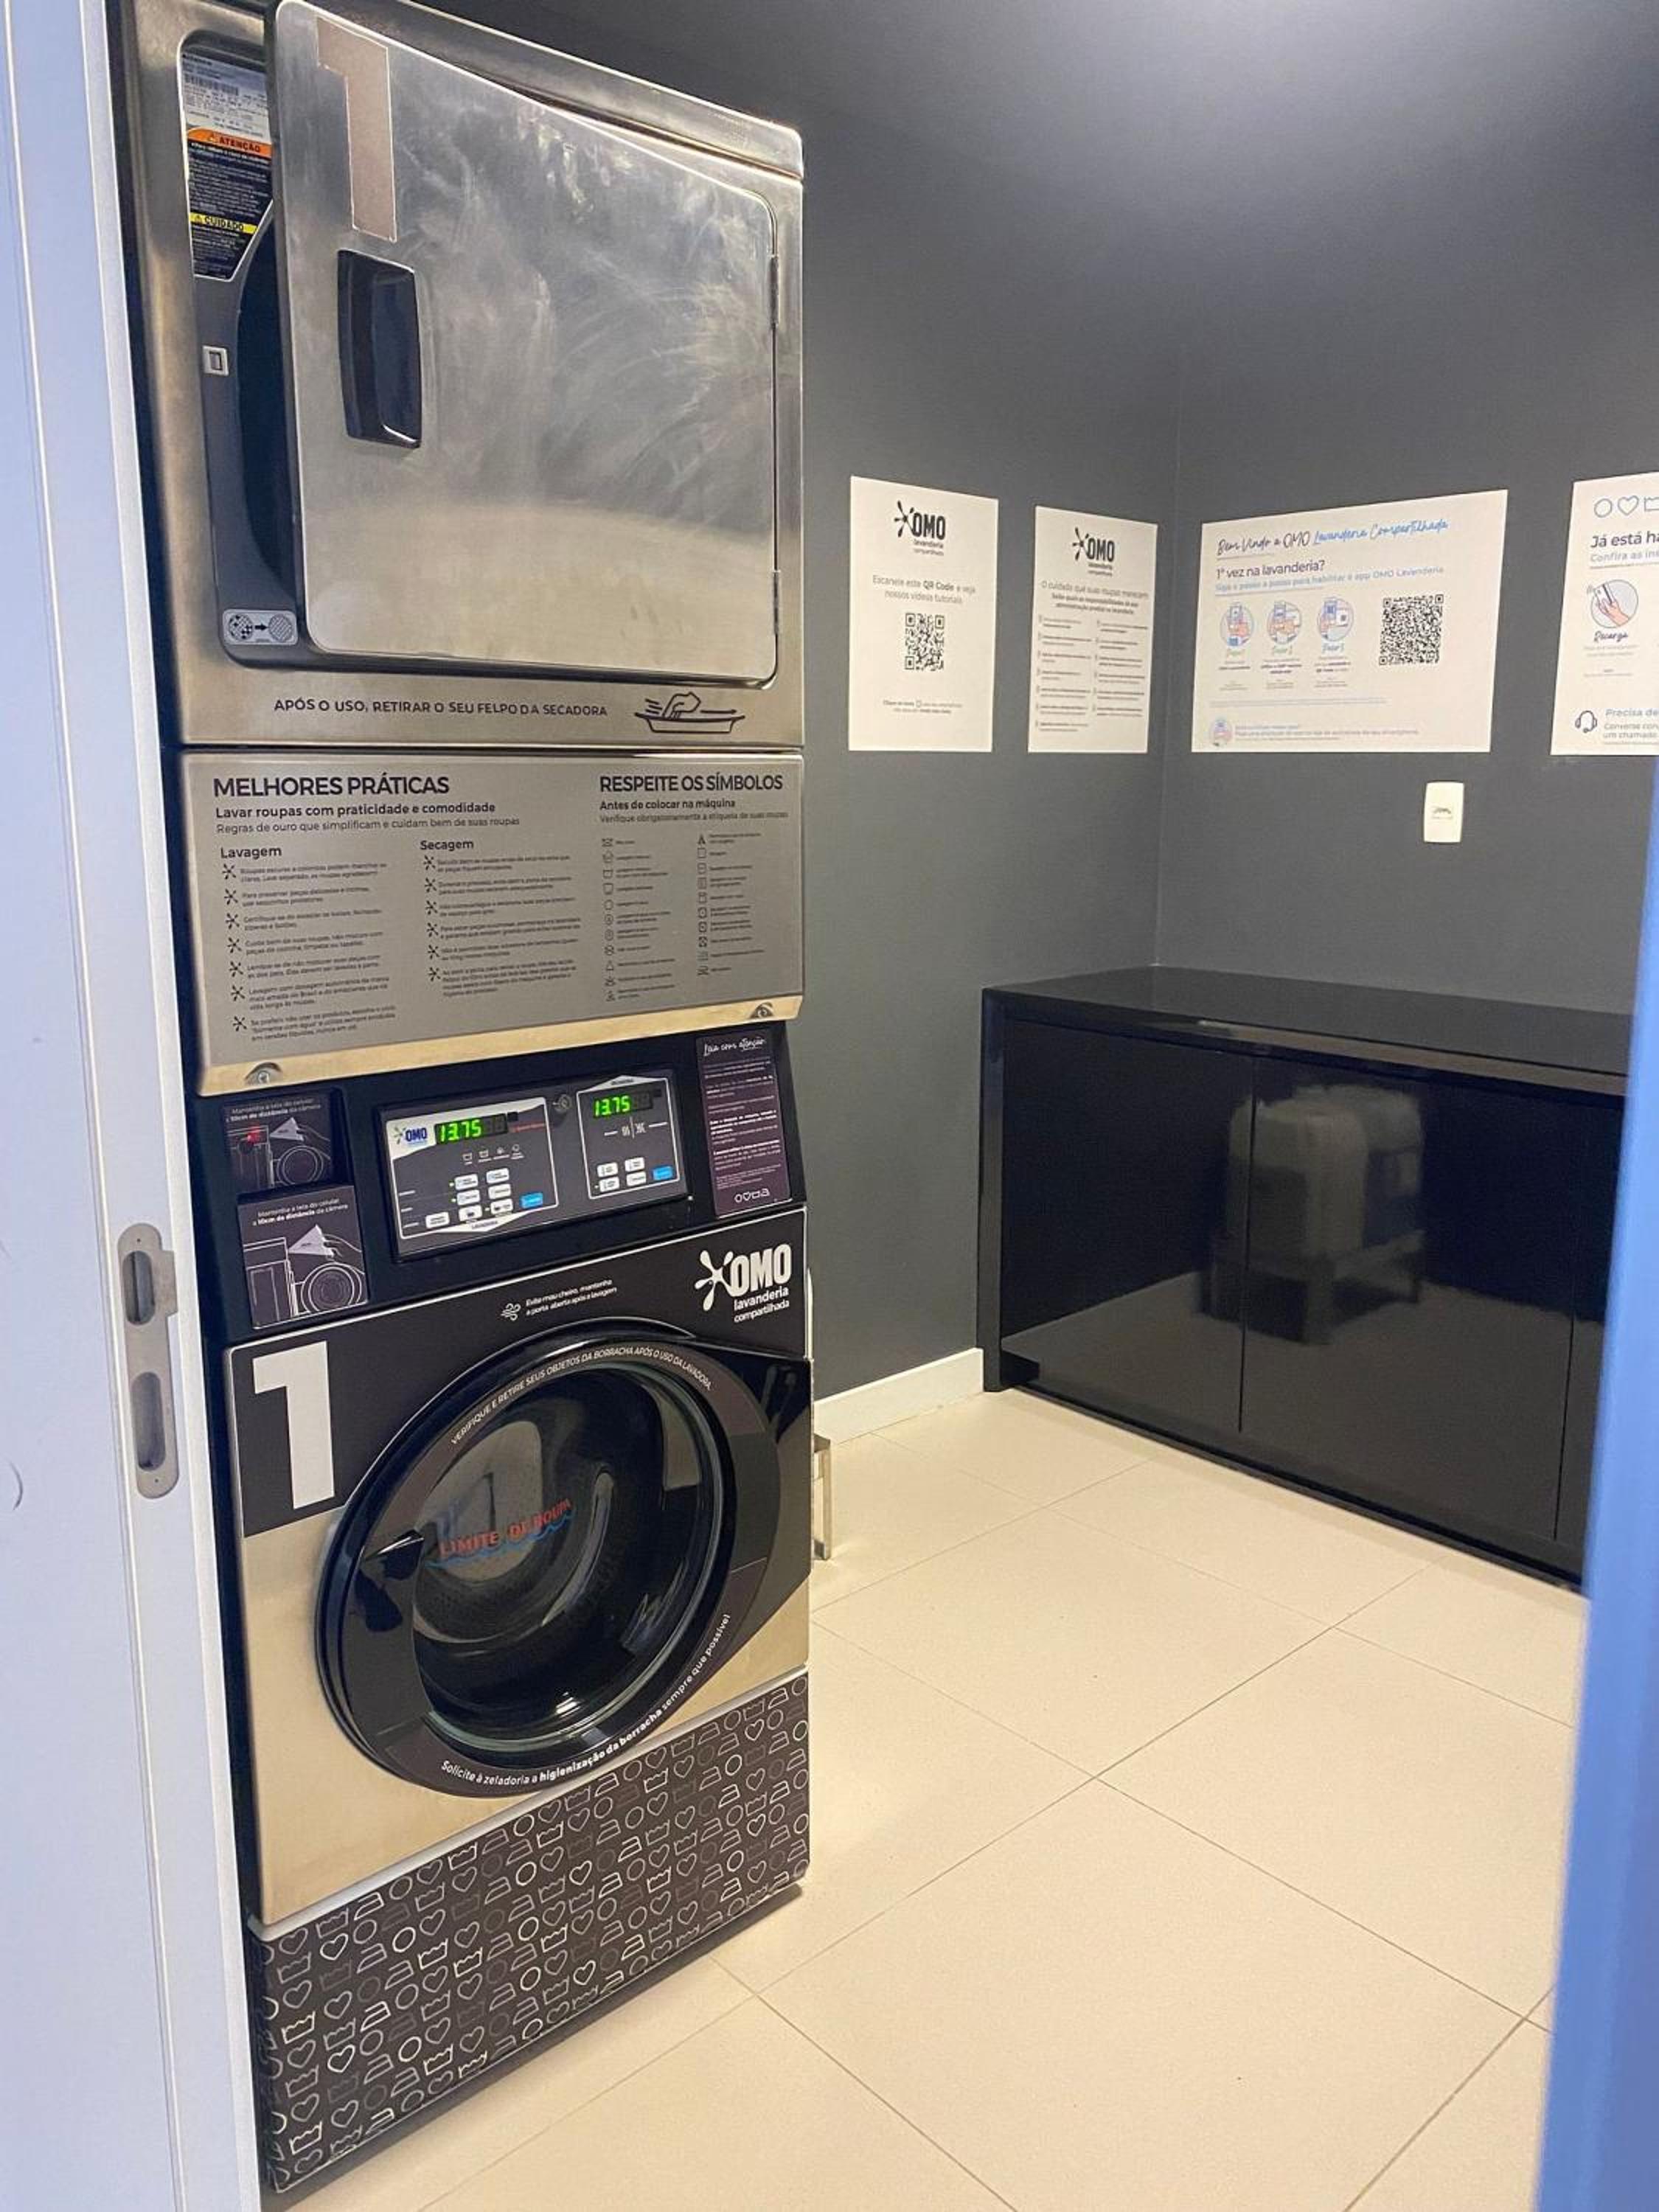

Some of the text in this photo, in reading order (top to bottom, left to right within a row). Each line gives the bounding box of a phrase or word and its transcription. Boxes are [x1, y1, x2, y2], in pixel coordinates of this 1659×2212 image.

[219, 136, 261, 153] ATENÇÃO
[204, 215, 244, 232] CUIDADO
[911, 512, 946, 540] OMO
[1217, 539, 1240, 556] Bem
[1242, 536, 1272, 552] Vindo
[1284, 530, 1311, 549] OMO
[1312, 529, 1369, 546] Lavanderia
[1590, 534, 1607, 548] Já
[1611, 531, 1642, 546] está
[1087, 538, 1116, 563] OMO
[1590, 549, 1628, 563] Confira
[1226, 569, 1245, 578] vez
[1246, 568, 1260, 577] na
[1262, 560, 1326, 575] lavanderia?
[1373, 569, 1394, 579] OMO
[922, 580, 934, 591] QR
[936, 580, 954, 591] Code
[274, 698, 316, 712] APÓS
[319, 700, 330, 712] O
[372, 701, 431, 713] RETIRAR
[434, 703, 445, 713] O
[448, 702, 474, 713] SEU
[478, 703, 517, 714] FELPO
[520, 704, 540, 714] DA
[543, 704, 608, 716] SECADORA
[1605, 709, 1643, 717] Precisa
[214, 773, 450, 797] MELHORES PRÁTICAS
[599, 772, 784, 793] RESPEITE OS SÍMBOLOS
[215, 807, 253, 818] Lavar
[256, 807, 302, 819] roupas
[305, 807, 334, 816] com
[337, 804, 409, 818] praticidade
[422, 802, 495, 814] comodidade
[599, 799, 736, 810] Antes de colocar na máquina
[216, 824, 254, 835] Regras
[257, 823, 271, 832] de
[272, 824, 297, 832] ouro
[299, 823, 319, 833] que
[322, 819, 381, 831] simplificam
[392, 818, 428, 828] cuidam
[431, 818, 452, 827] bem
[454, 818, 467, 827] de
[468, 818, 488, 827] suas
[490, 818, 520, 827] roupas
[220, 847, 282, 860] Lavagem
[420, 840, 474, 852] Secagem
[406, 1127, 428, 1142] OMO
[729, 1243, 792, 1297] OMO
[734, 1285, 789, 1311] lavanderia
[734, 1298, 790, 1323] compartilhada
[451, 1406, 491, 1445] VERIFIQUE
[491, 1399, 498, 1409] E
[498, 1381, 525, 1405] RETIRE
[526, 1369, 546, 1384] SEUS
[546, 1356, 581, 1375] OBJETOS
[581, 1352, 592, 1363] DA
[594, 1346, 633, 1360] BORRACHA
[634, 1346, 653, 1357] APÓS
[653, 1349, 660, 1358] O
[659, 1351, 674, 1363] USO
[672, 1355, 682, 1366] DA
[252, 1340, 335, 1509] 1
[439, 1529, 499, 1557] LIMITE
[442, 1759, 475, 1781] Solicite
[483, 1773, 530, 1786] zeladoria
[539, 1750, 605, 1782] higienização
[606, 1742, 619, 1755] da
[619, 1708, 663, 1746] borracha
[662, 1674, 693, 1711] sempre
[691, 1655, 708, 1676] que
[705, 1613, 731, 1657] possível
